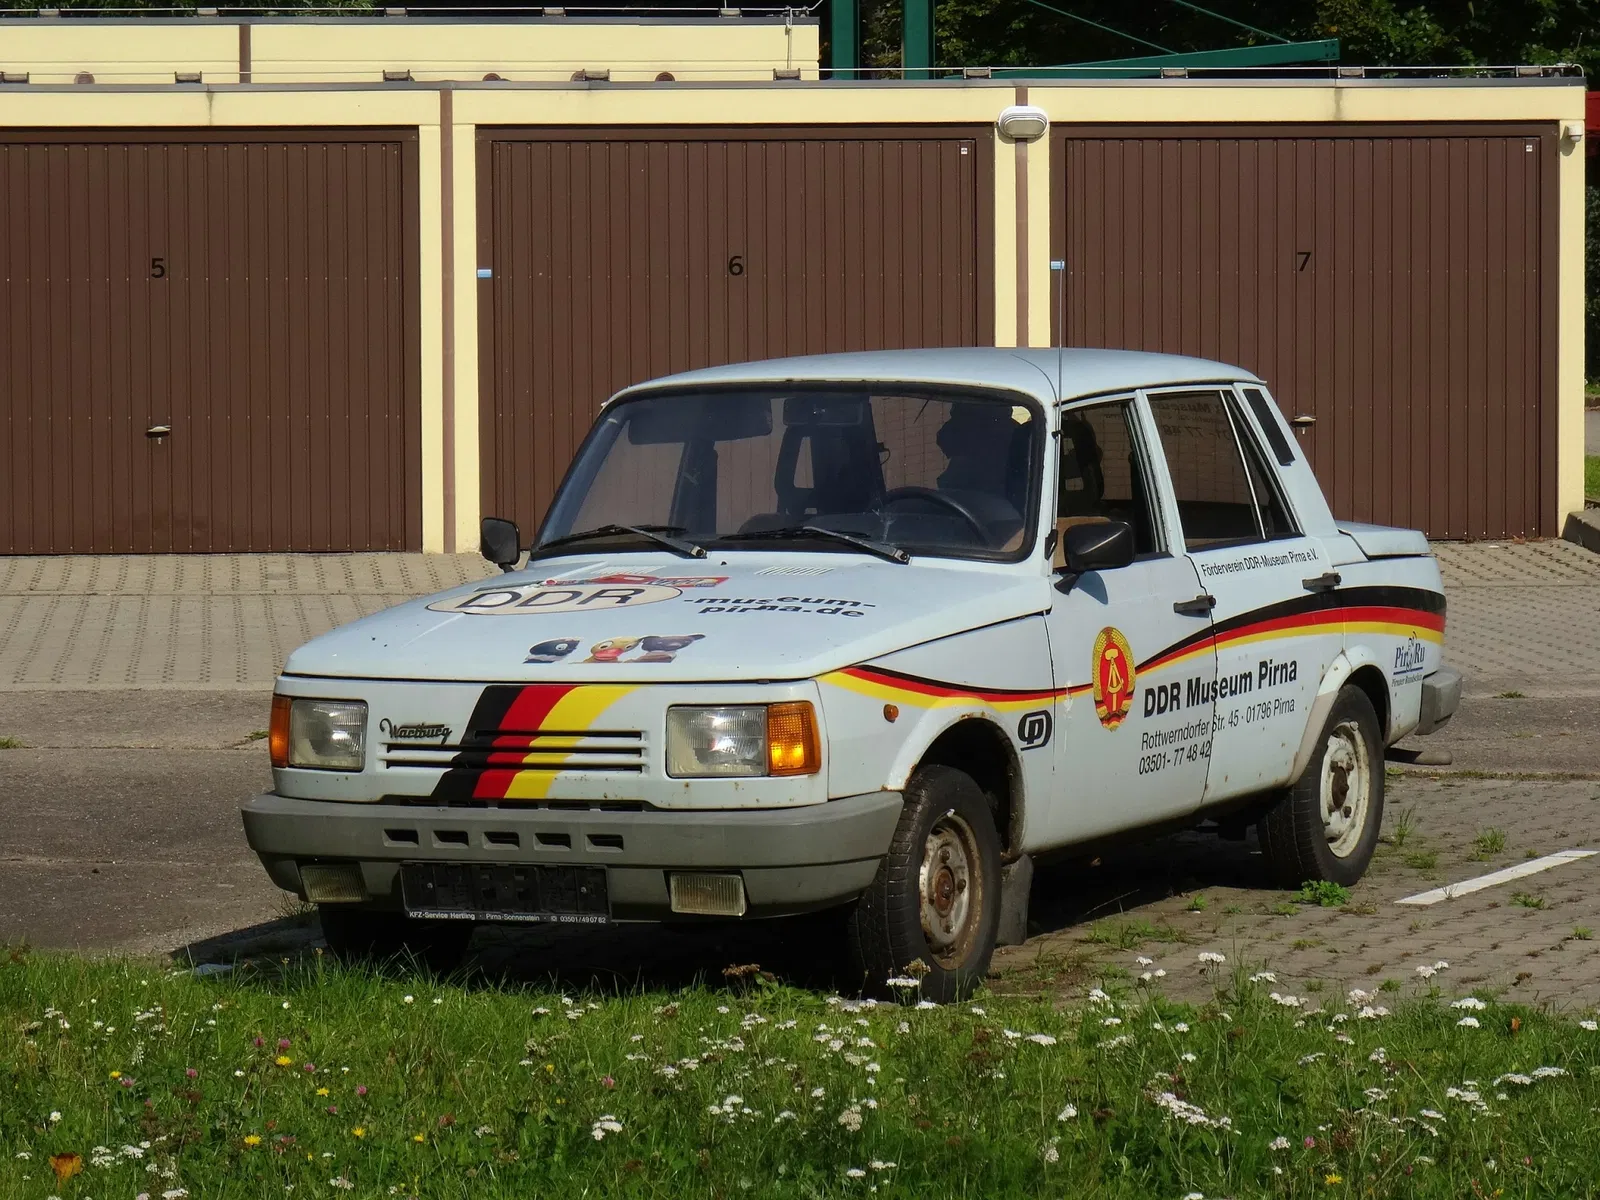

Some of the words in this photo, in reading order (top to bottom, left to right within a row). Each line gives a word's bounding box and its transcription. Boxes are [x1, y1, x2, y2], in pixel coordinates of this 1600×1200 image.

[151, 257, 165, 278] 5
[729, 255, 743, 276] 6
[1297, 251, 1311, 271] 7
[1201, 559, 1245, 577] Förderverein
[1243, 555, 1290, 570] DDR-Museum
[1289, 550, 1306, 563] Pirna
[1307, 548, 1319, 561] e.V.
[454, 587, 646, 609] DDR
[698, 605, 865, 618] pirna.de
[1143, 681, 1181, 718] DDR
[1186, 670, 1253, 708] Museum
[1258, 659, 1297, 690] Pirna
[379, 717, 453, 746] Wartburg
[1141, 719, 1211, 751] Rottwerndorfer
[1212, 713, 1226, 732] Str.
[1228, 709, 1239, 727] 45
[1246, 702, 1272, 723] 01796
[1273, 698, 1295, 717] Pirna
[1138, 755, 1171, 775] 03501-
[1173, 747, 1185, 767] 77
[1186, 744, 1198, 762] 48
[1199, 740, 1212, 759] 42
